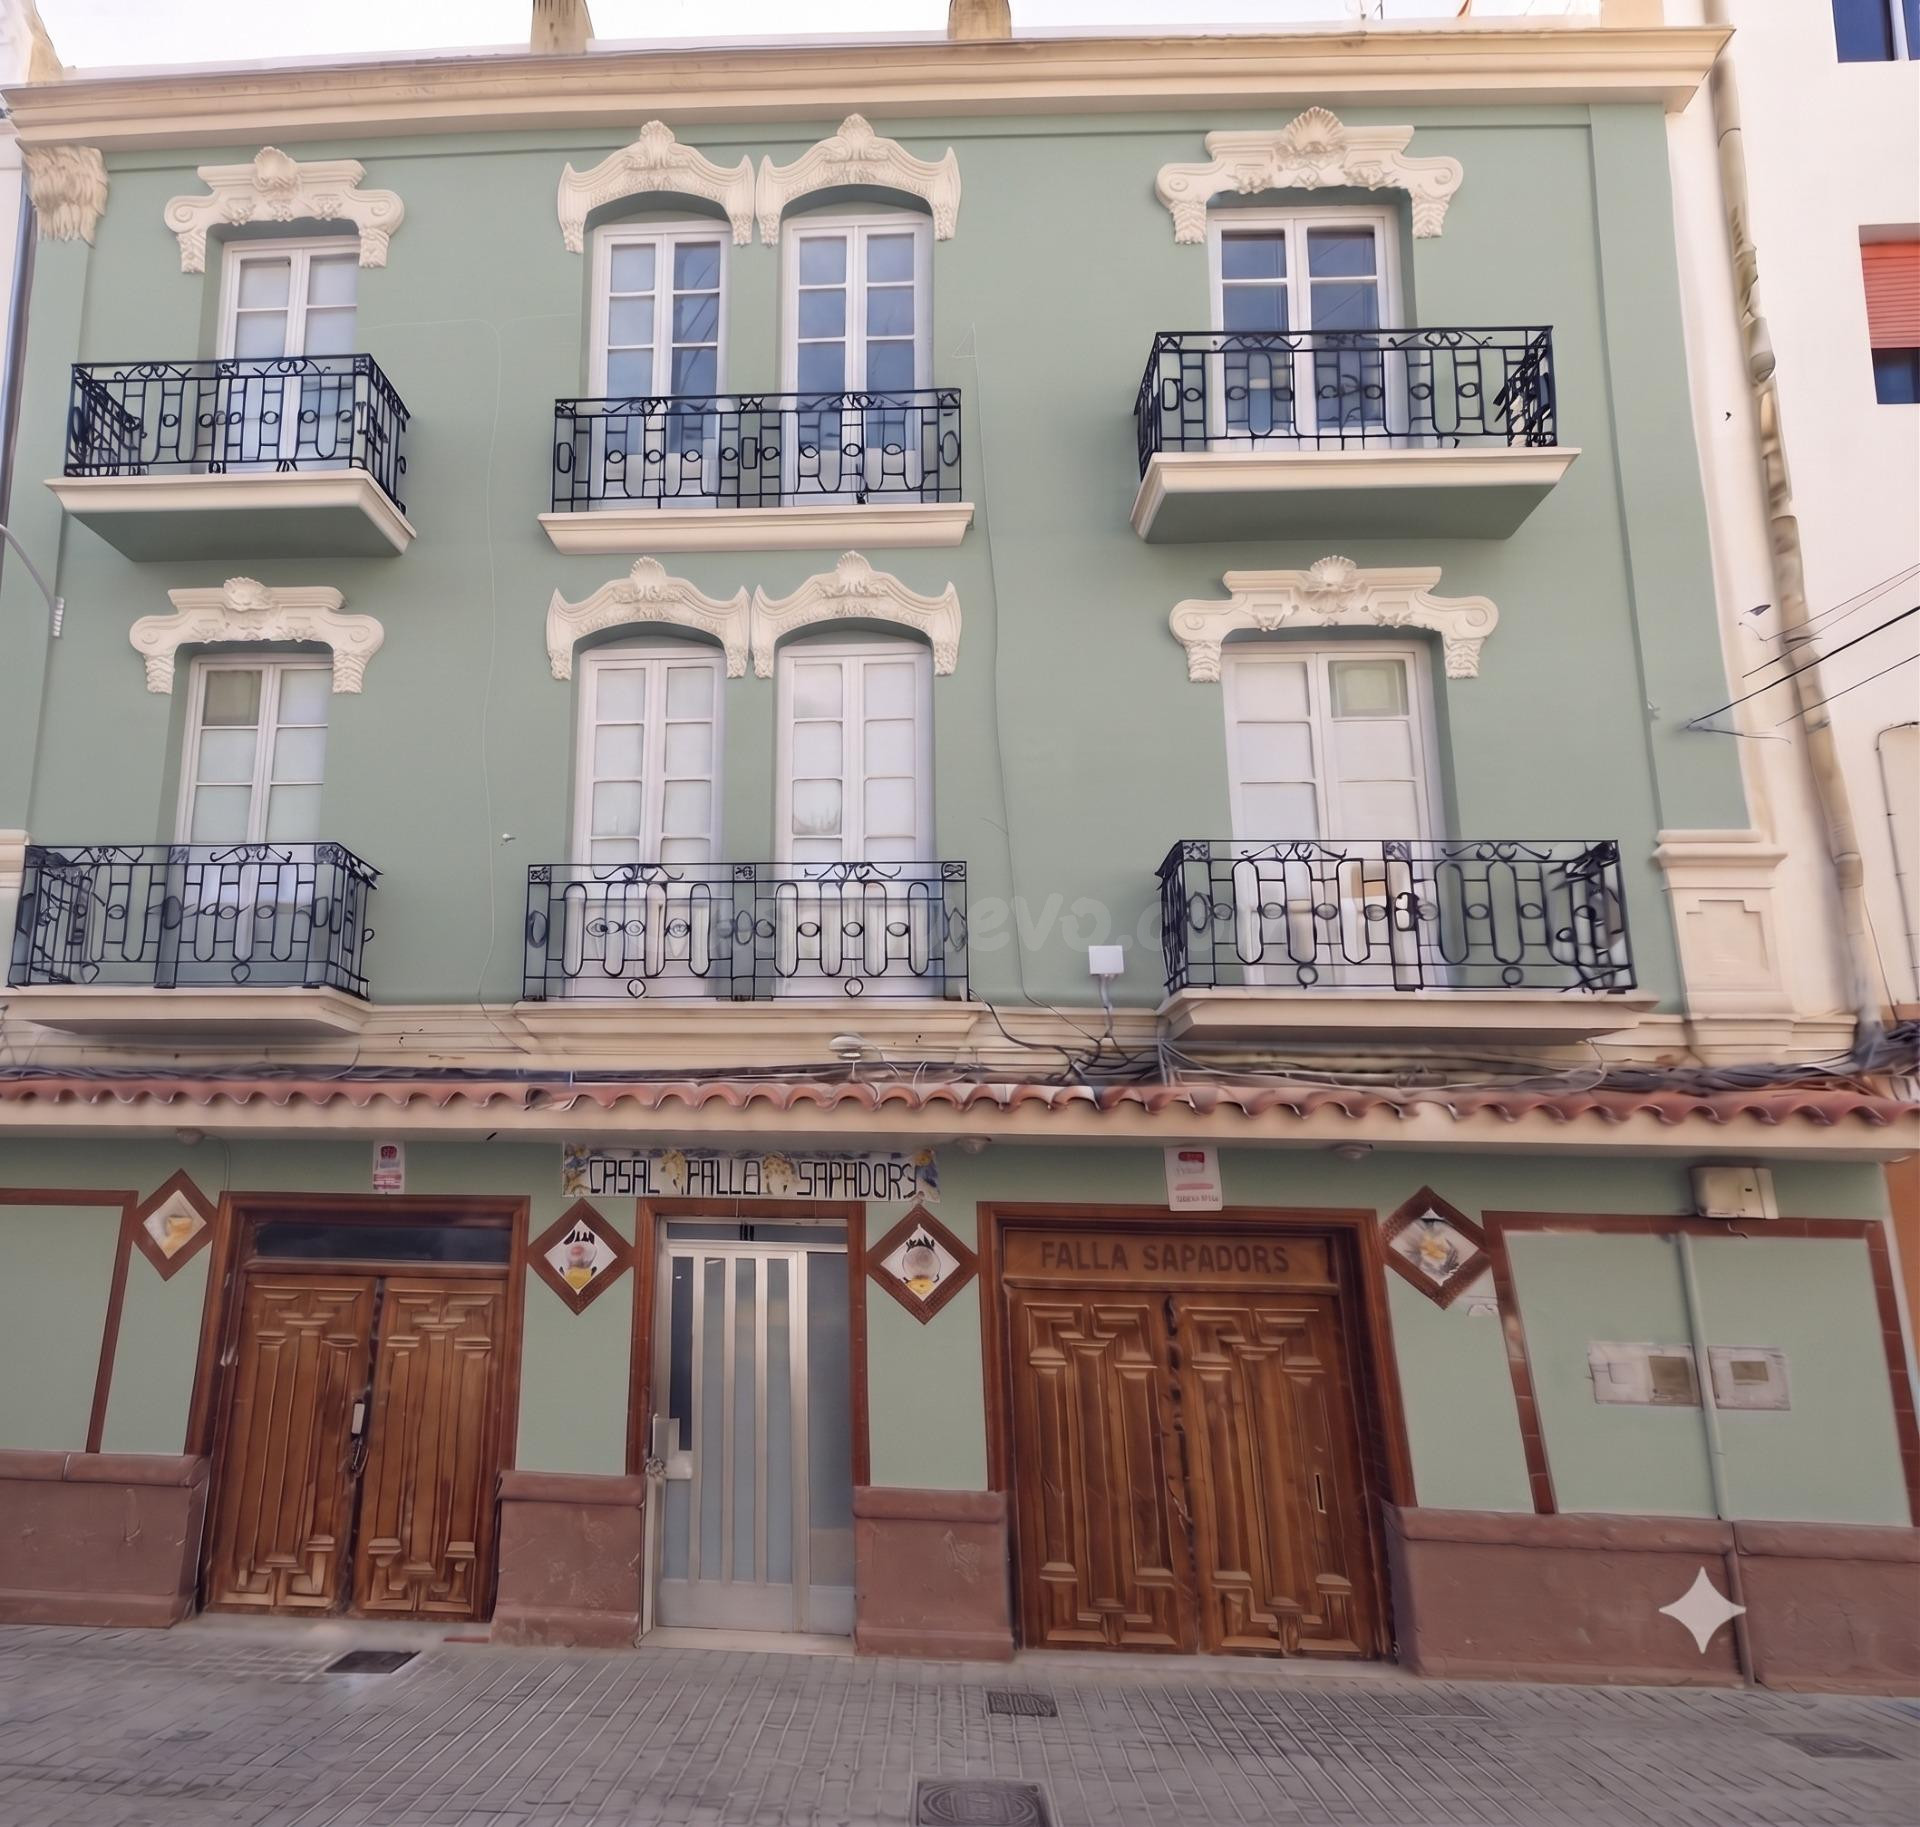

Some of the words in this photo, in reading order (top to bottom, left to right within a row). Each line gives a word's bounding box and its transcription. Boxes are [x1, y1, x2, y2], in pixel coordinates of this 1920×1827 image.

[589, 1159, 660, 1195] CASAL
[797, 1160, 917, 1200] SAPADORS
[1040, 1240, 1129, 1271] FALLA
[1143, 1242, 1291, 1273] SAPADORS
